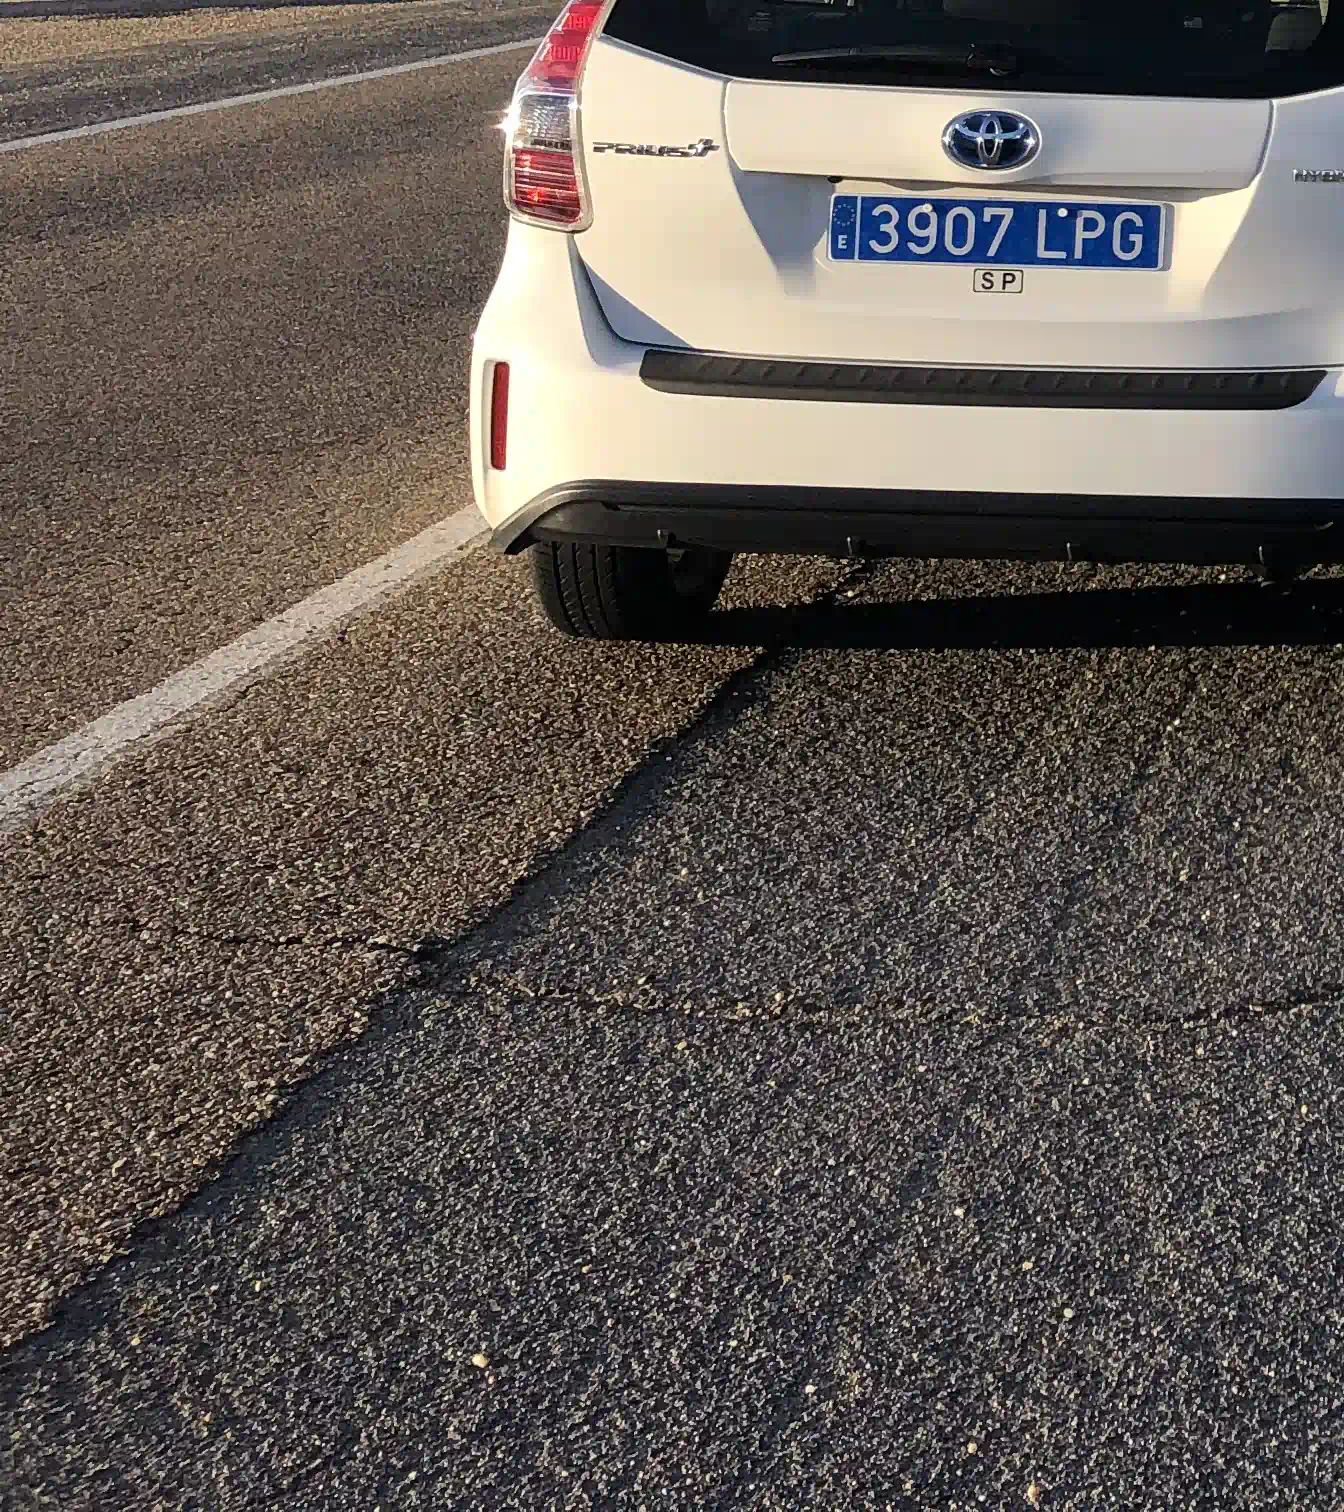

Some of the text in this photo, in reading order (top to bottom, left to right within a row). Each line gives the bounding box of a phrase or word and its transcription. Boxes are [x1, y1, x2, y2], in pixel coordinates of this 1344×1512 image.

[837, 235, 848, 249] E
[868, 203, 1145, 261] 3907 LPG
